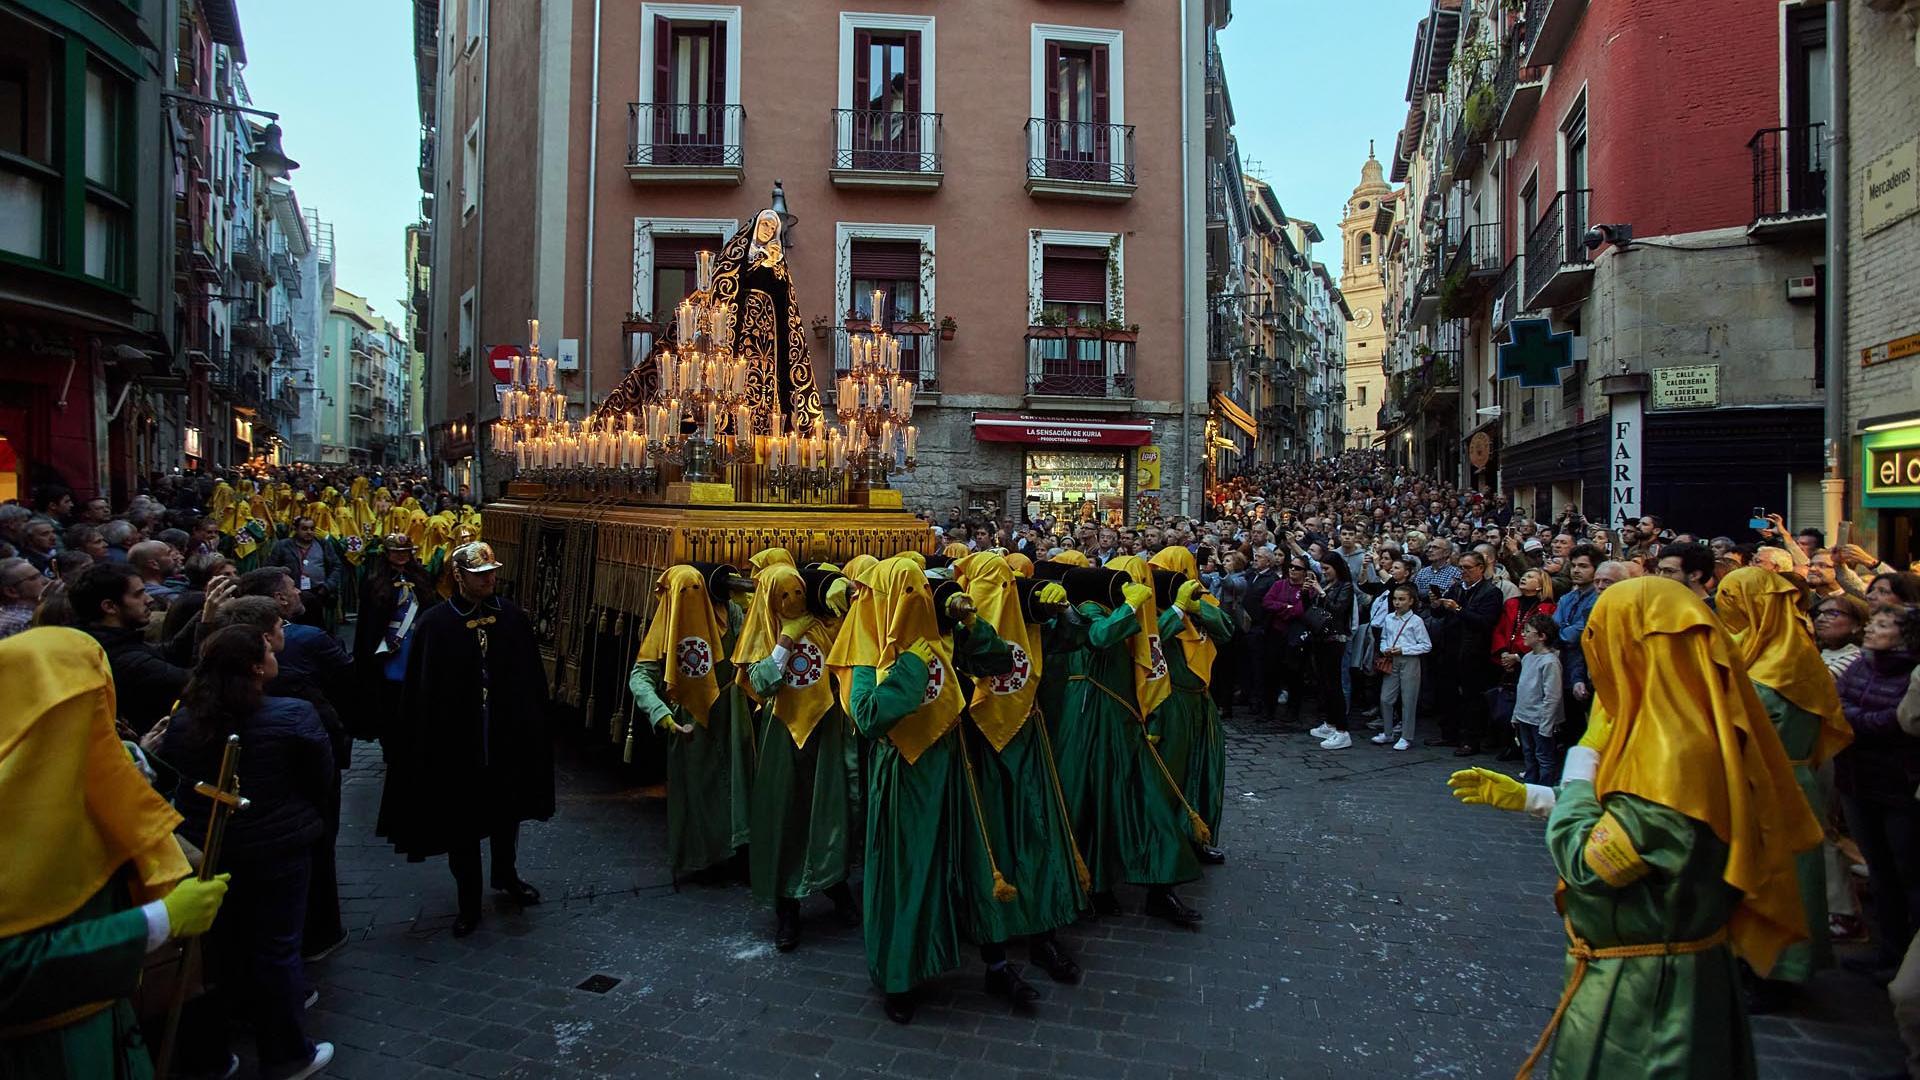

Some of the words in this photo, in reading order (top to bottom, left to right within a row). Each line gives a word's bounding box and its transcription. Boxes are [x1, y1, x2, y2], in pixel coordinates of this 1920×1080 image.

[1868, 168, 1911, 201] Mercaderes
[1036, 429, 1072, 437] SENSACIÓN
[1613, 421, 1635, 532] FARMA
[1880, 452, 1900, 485] el
